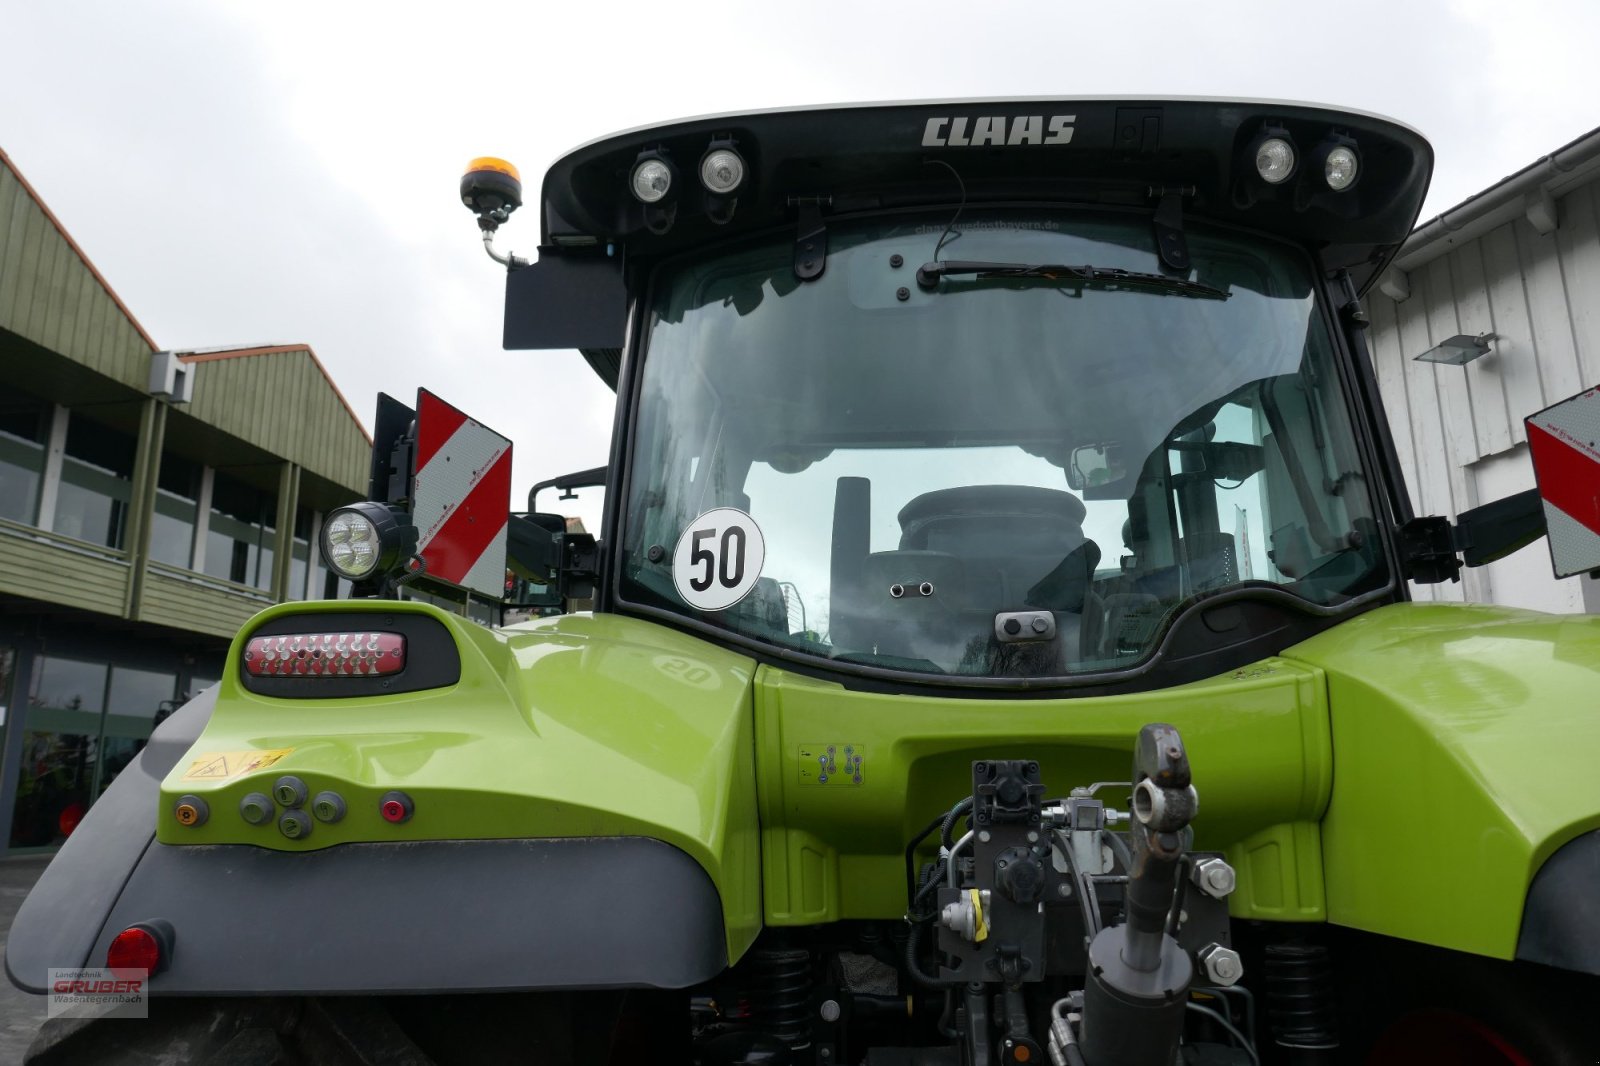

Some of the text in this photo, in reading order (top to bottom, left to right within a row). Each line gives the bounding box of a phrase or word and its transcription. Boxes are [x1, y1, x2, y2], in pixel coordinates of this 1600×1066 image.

[921, 115, 1077, 147] CLAAS
[914, 219, 1060, 235] claassuedostbayern.de
[689, 525, 746, 592] 50
